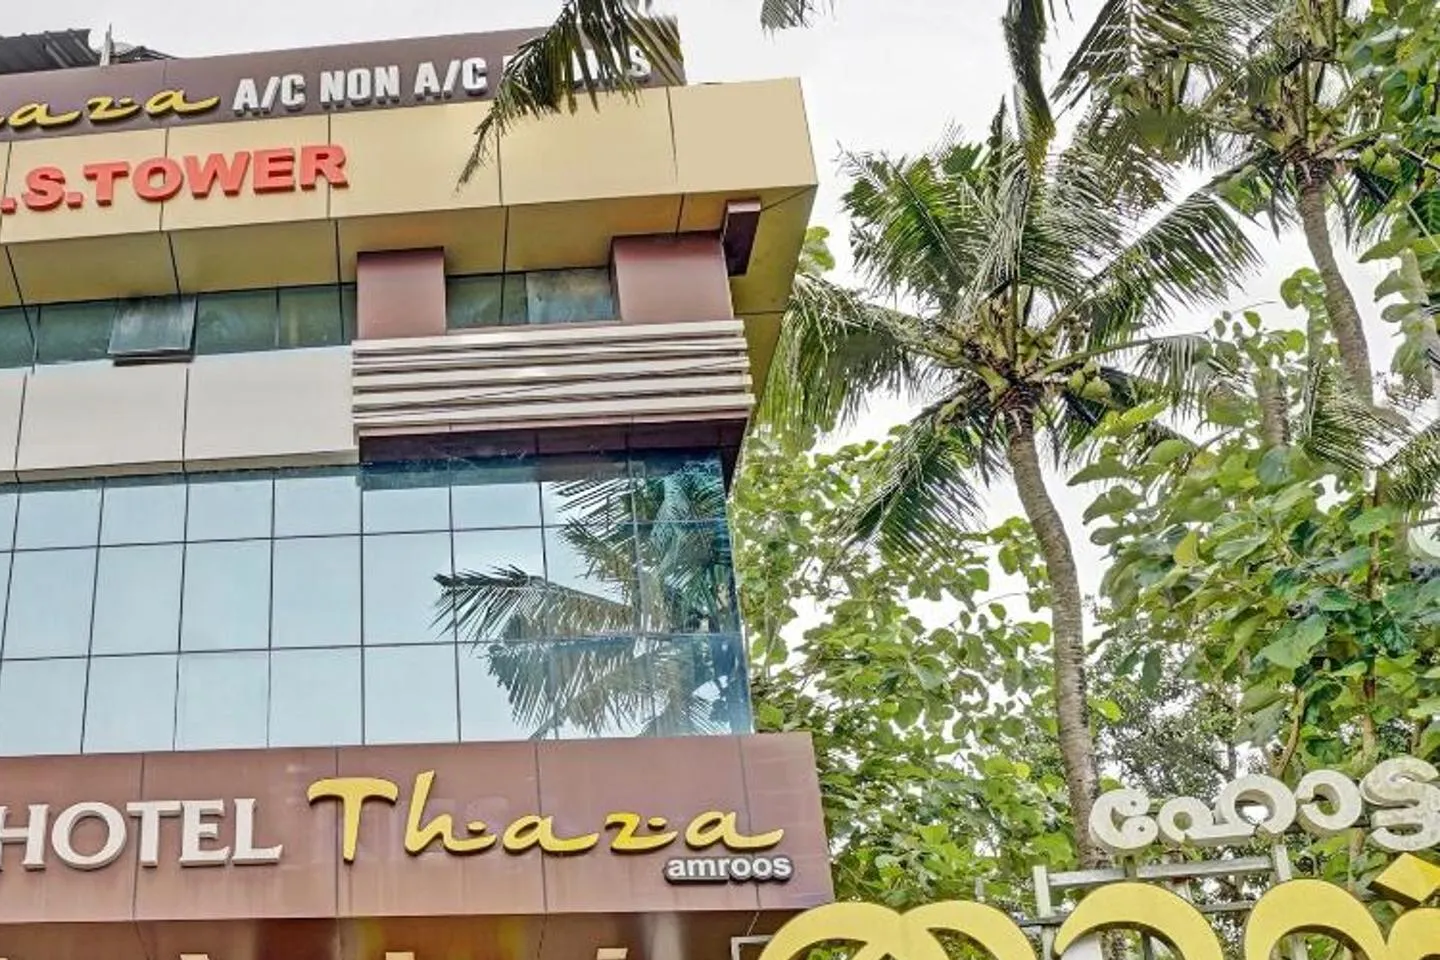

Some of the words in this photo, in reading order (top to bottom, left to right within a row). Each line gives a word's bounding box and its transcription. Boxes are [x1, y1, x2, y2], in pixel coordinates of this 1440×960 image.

[232, 74, 306, 116] A/C
[320, 65, 401, 111] NON
[414, 56, 488, 101] A/C
[308, 770, 786, 863] Thaza
[666, 854, 794, 883] amroos
